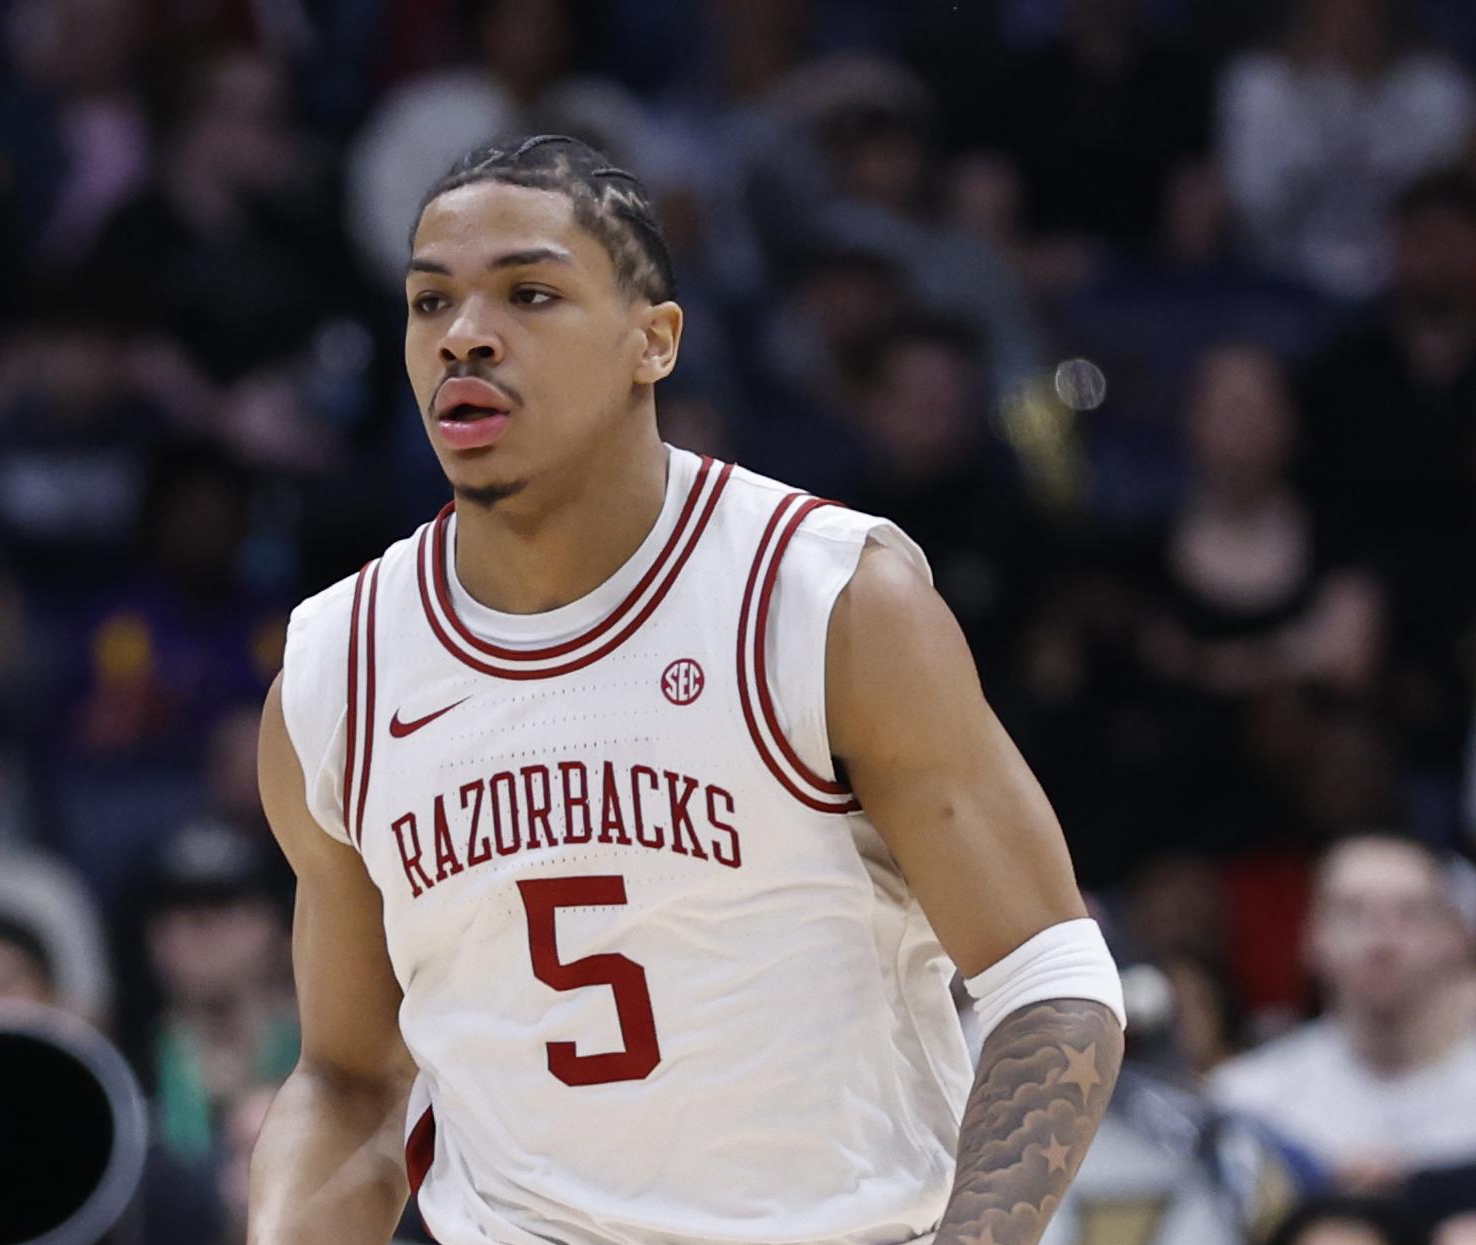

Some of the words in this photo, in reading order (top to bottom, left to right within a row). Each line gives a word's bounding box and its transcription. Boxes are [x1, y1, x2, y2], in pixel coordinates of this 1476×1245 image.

[663, 661, 702, 702] SEC
[391, 760, 742, 900] RAZORBACKS
[516, 874, 661, 1087] 5
